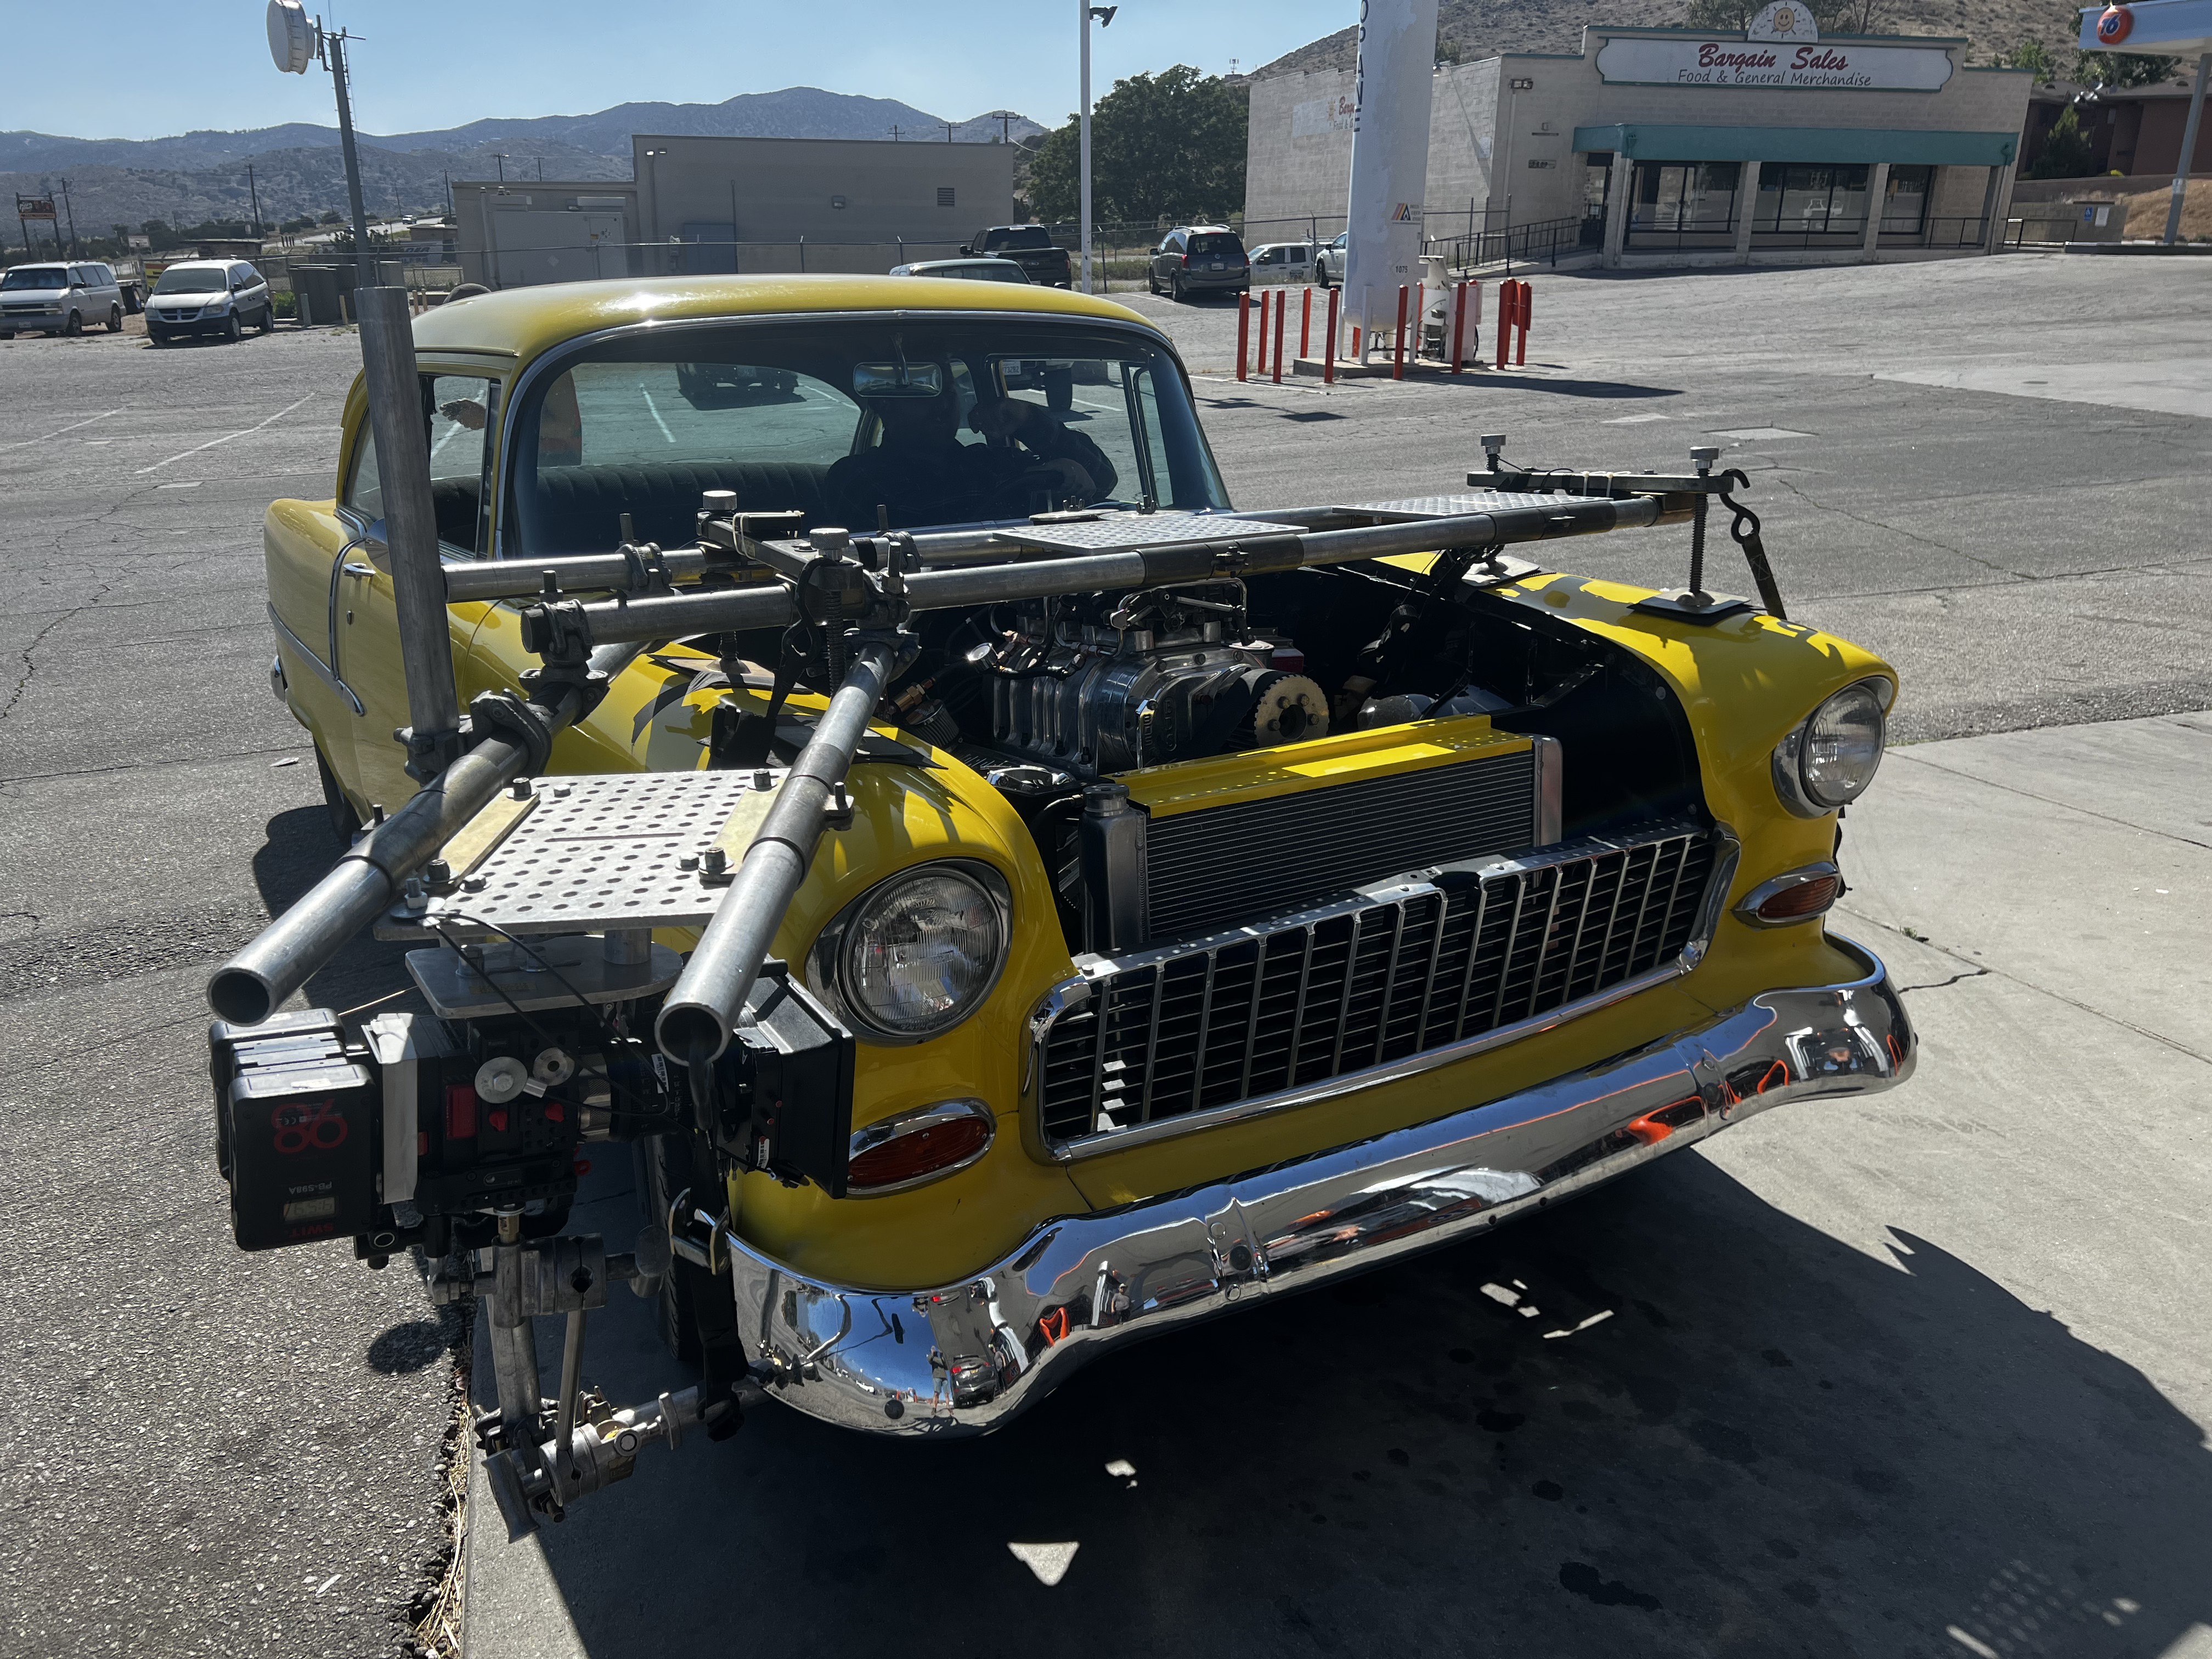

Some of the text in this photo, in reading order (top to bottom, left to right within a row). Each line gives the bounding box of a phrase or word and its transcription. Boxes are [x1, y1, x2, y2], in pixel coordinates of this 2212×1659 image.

[2100, 14, 2121, 35] 76
[1699, 43, 1848, 73] Bargain Sales
[1678, 69, 1871, 86] Food & General Merchandise
[272, 1098, 348, 1153] 98
[288, 1181, 332, 1194] PB-S98A
[290, 1222, 334, 1238] SWIT
